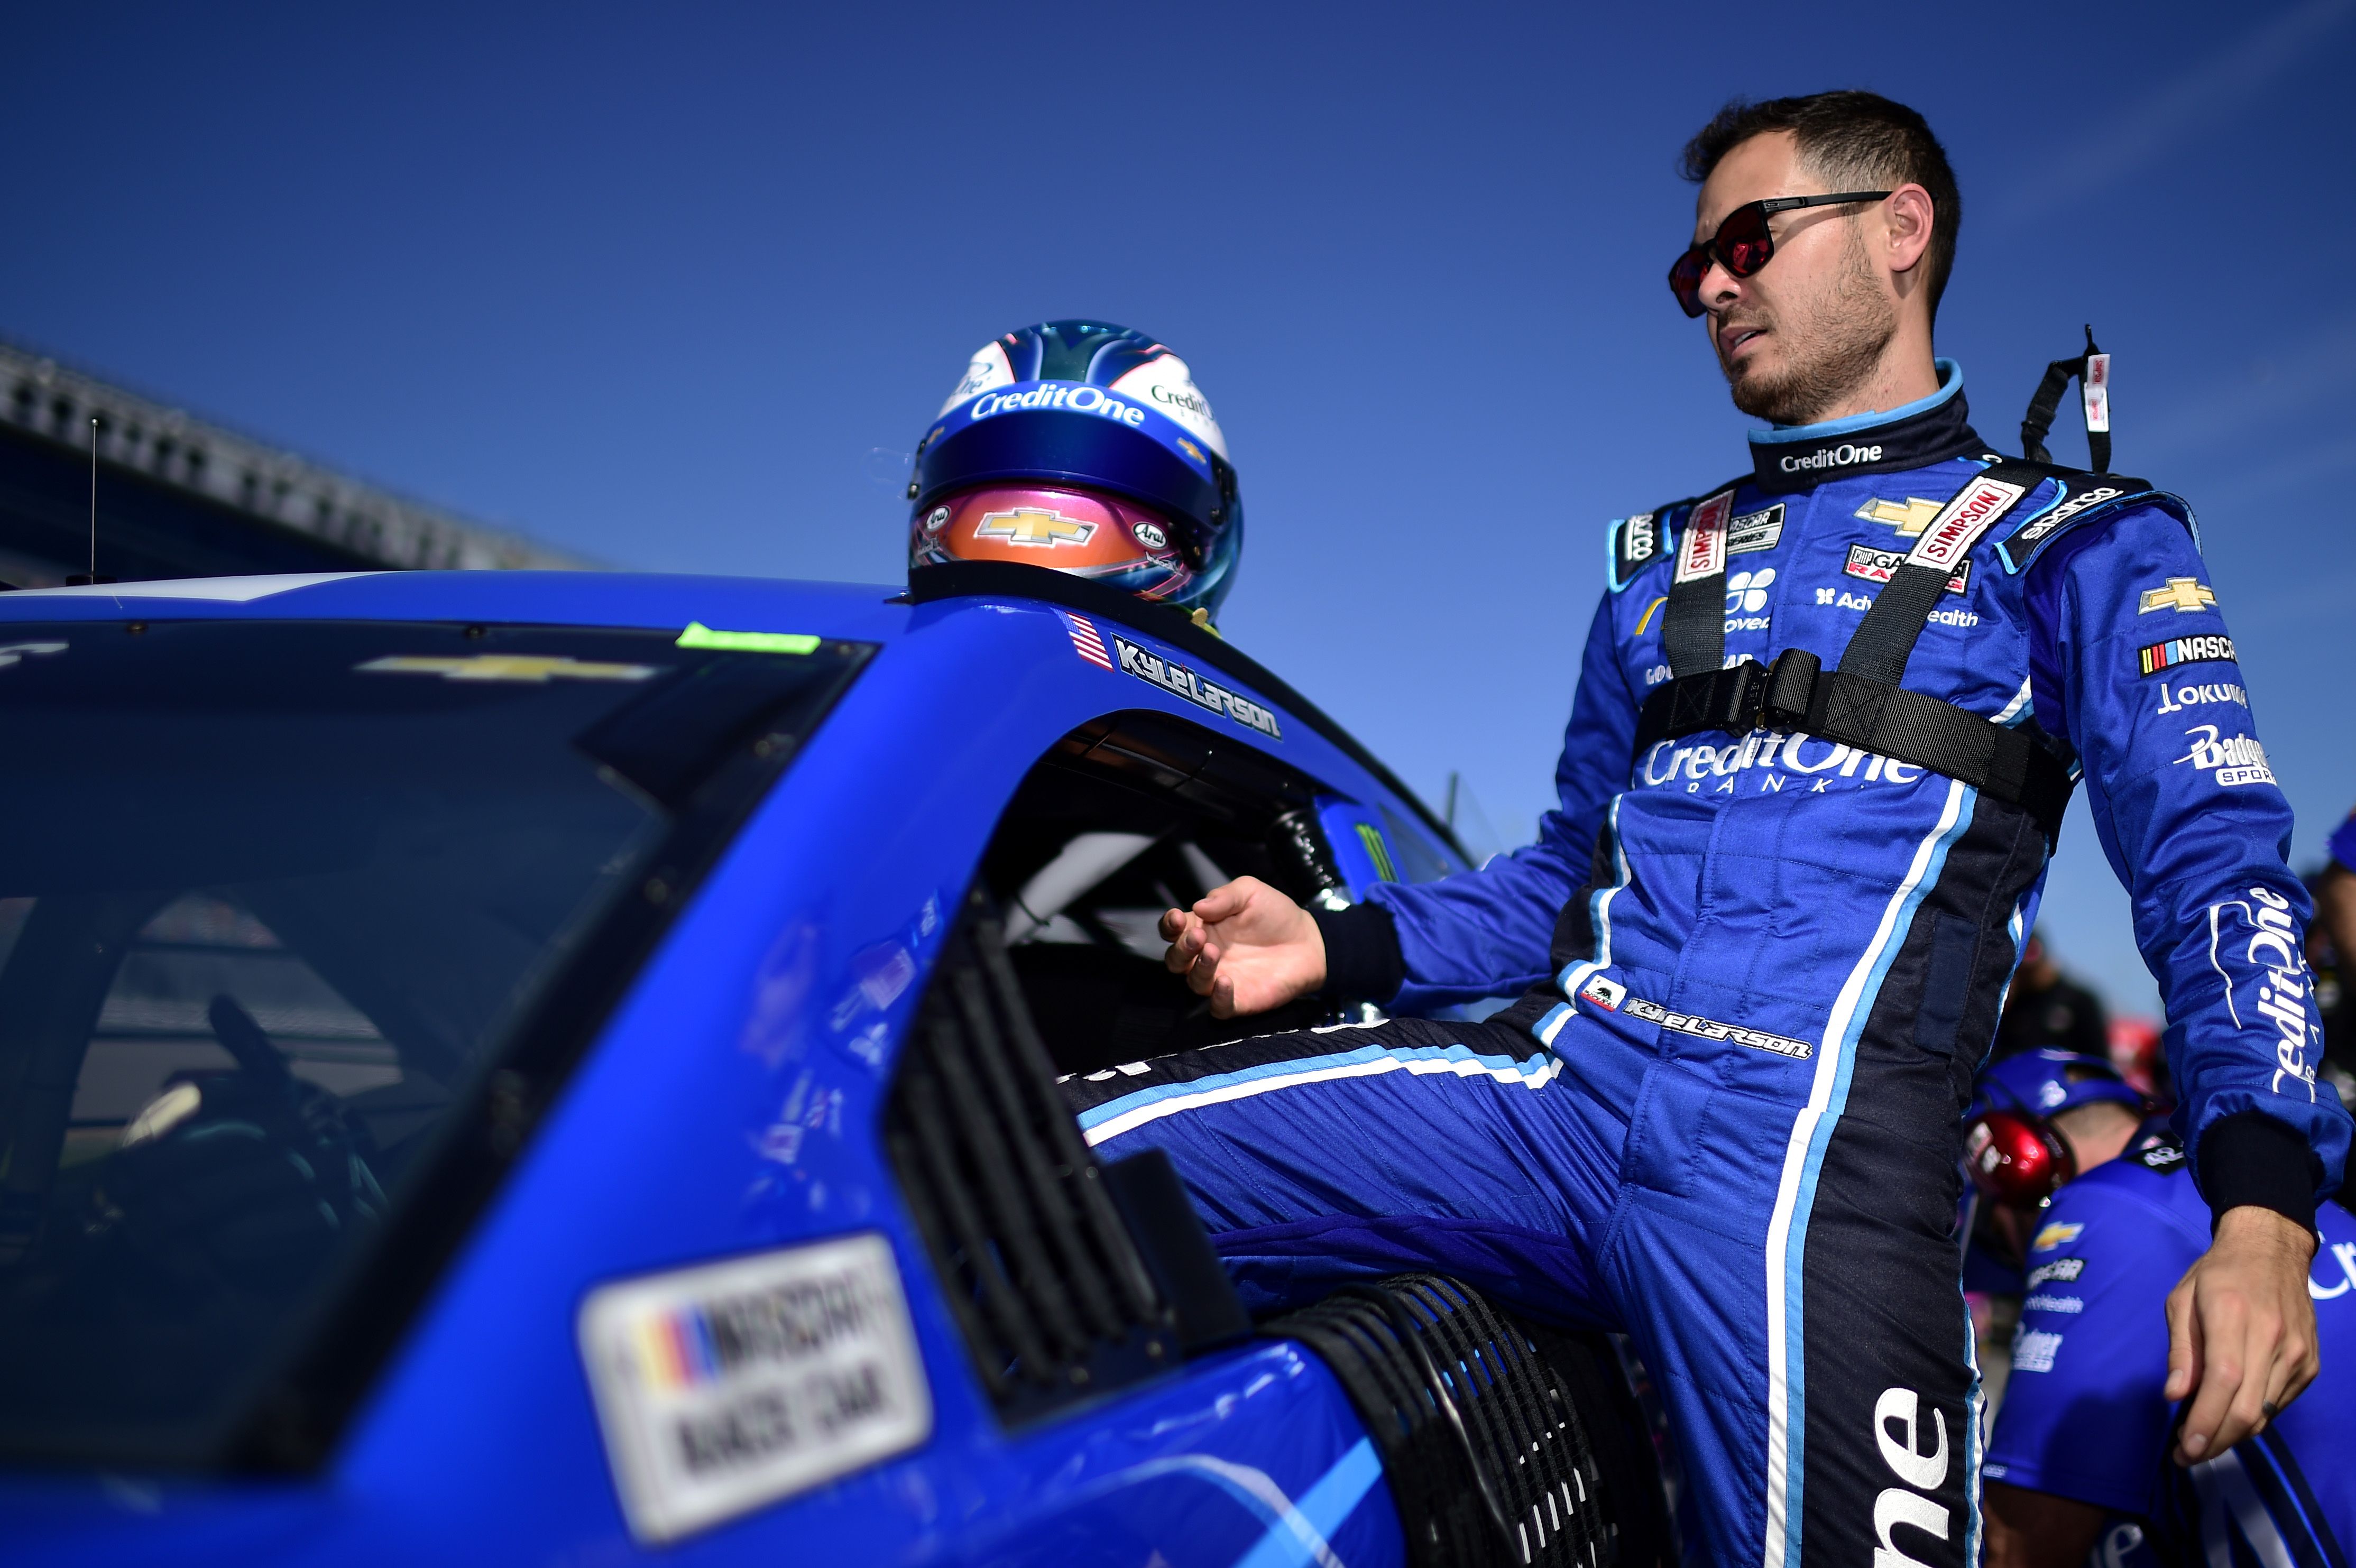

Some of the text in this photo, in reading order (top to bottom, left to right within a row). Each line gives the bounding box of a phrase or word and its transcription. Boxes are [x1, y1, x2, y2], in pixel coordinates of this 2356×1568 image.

[971, 383, 1145, 426] CreditOne
[1781, 445, 1882, 473] CreditOne
[1729, 511, 1771, 531] ASCAR
[1927, 490, 2002, 558] SIMPSON
[2022, 486, 2124, 541] sparco
[1136, 524, 1164, 544] Arai
[1691, 494, 1728, 569] SIMPSON
[1852, 548, 1873, 566] CHIP
[1725, 616, 1770, 633] over
[1644, 727, 1924, 786] CreditOne
[2222, 769, 2276, 783] SPOR
[2247, 887, 2315, 1103] editOne
